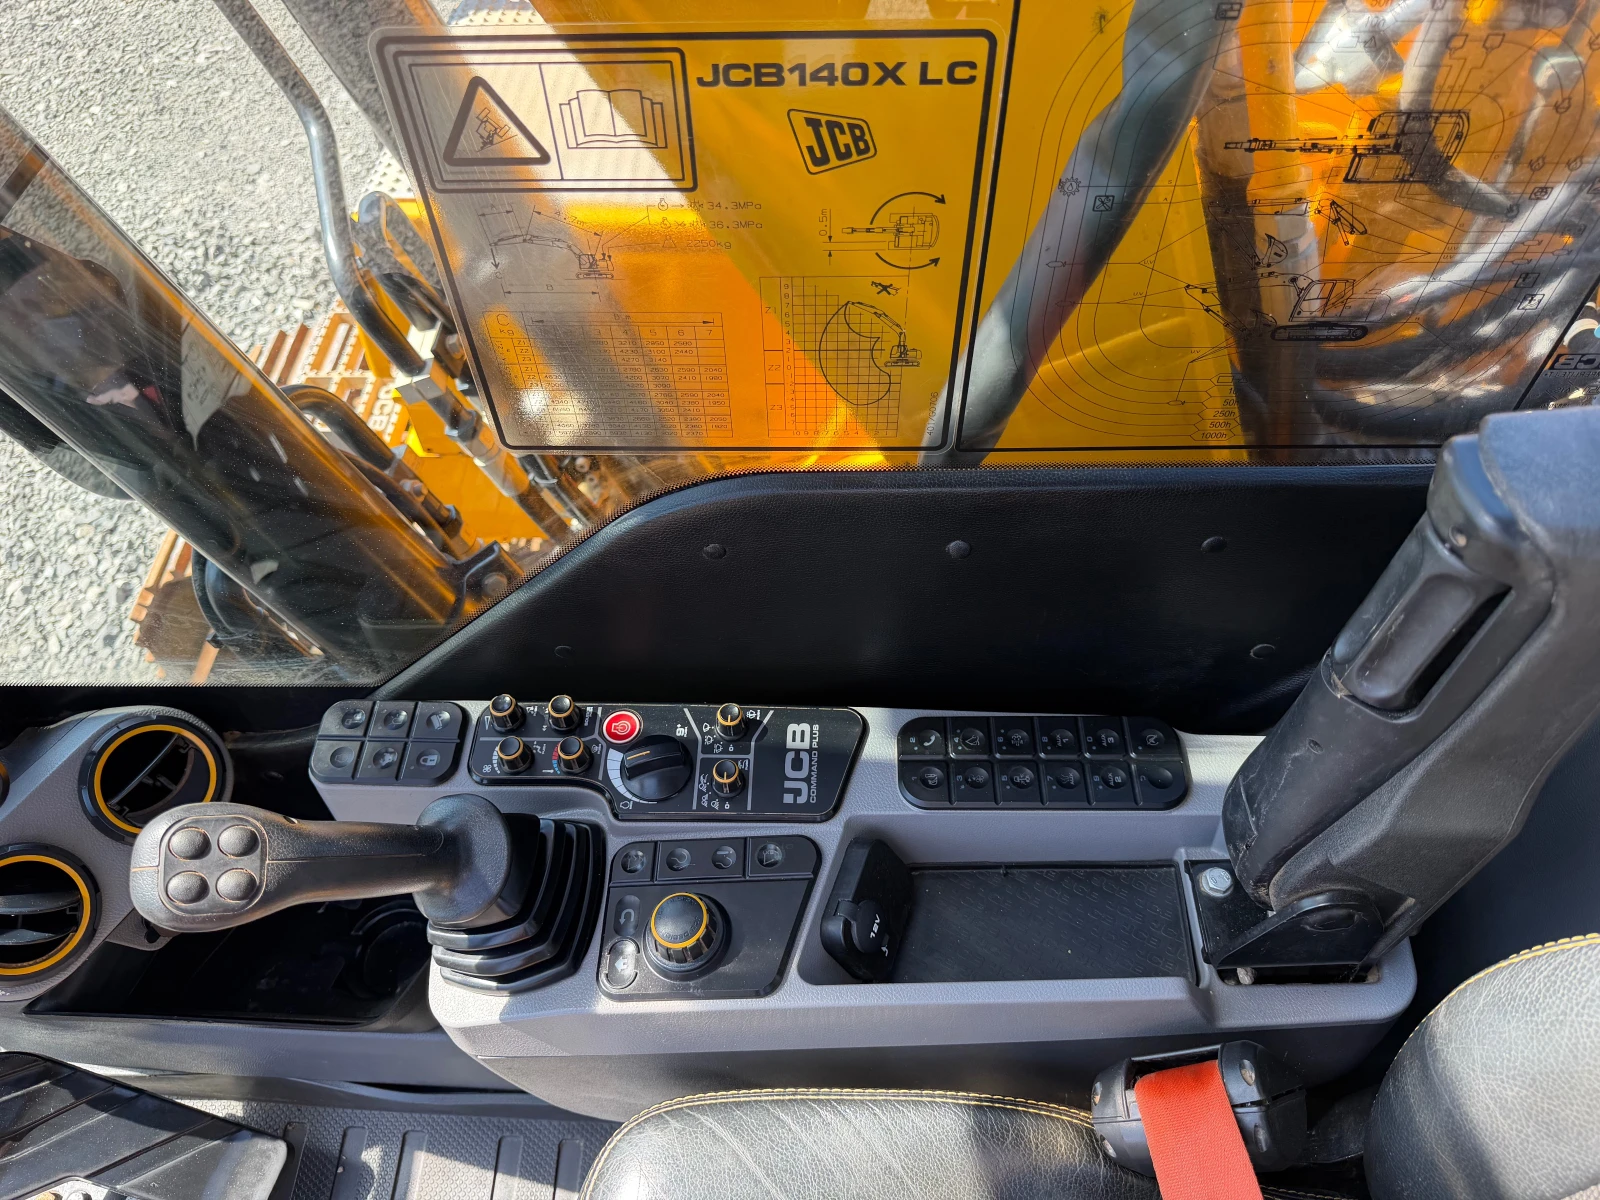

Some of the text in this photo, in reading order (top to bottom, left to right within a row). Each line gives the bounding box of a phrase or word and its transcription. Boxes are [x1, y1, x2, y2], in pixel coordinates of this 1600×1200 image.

[696, 60, 977, 87] JCB140X LC
[804, 116, 871, 167] JCB
[706, 201, 762, 210] 34.3MPa
[708, 220, 763, 230] 36.3MPa
[818, 208, 828, 237] 0.5m
[496, 313, 510, 327] C
[499, 328, 515, 337] kg
[767, 364, 782, 372] Z2
[769, 403, 784, 411] Z3
[1212, 410, 1236, 418] 250h
[1208, 421, 1232, 429] 500h
[783, 722, 811, 804] JCB
[809, 724, 820, 804] COMMAND PLUS
[870, 913, 881, 939] 12V
